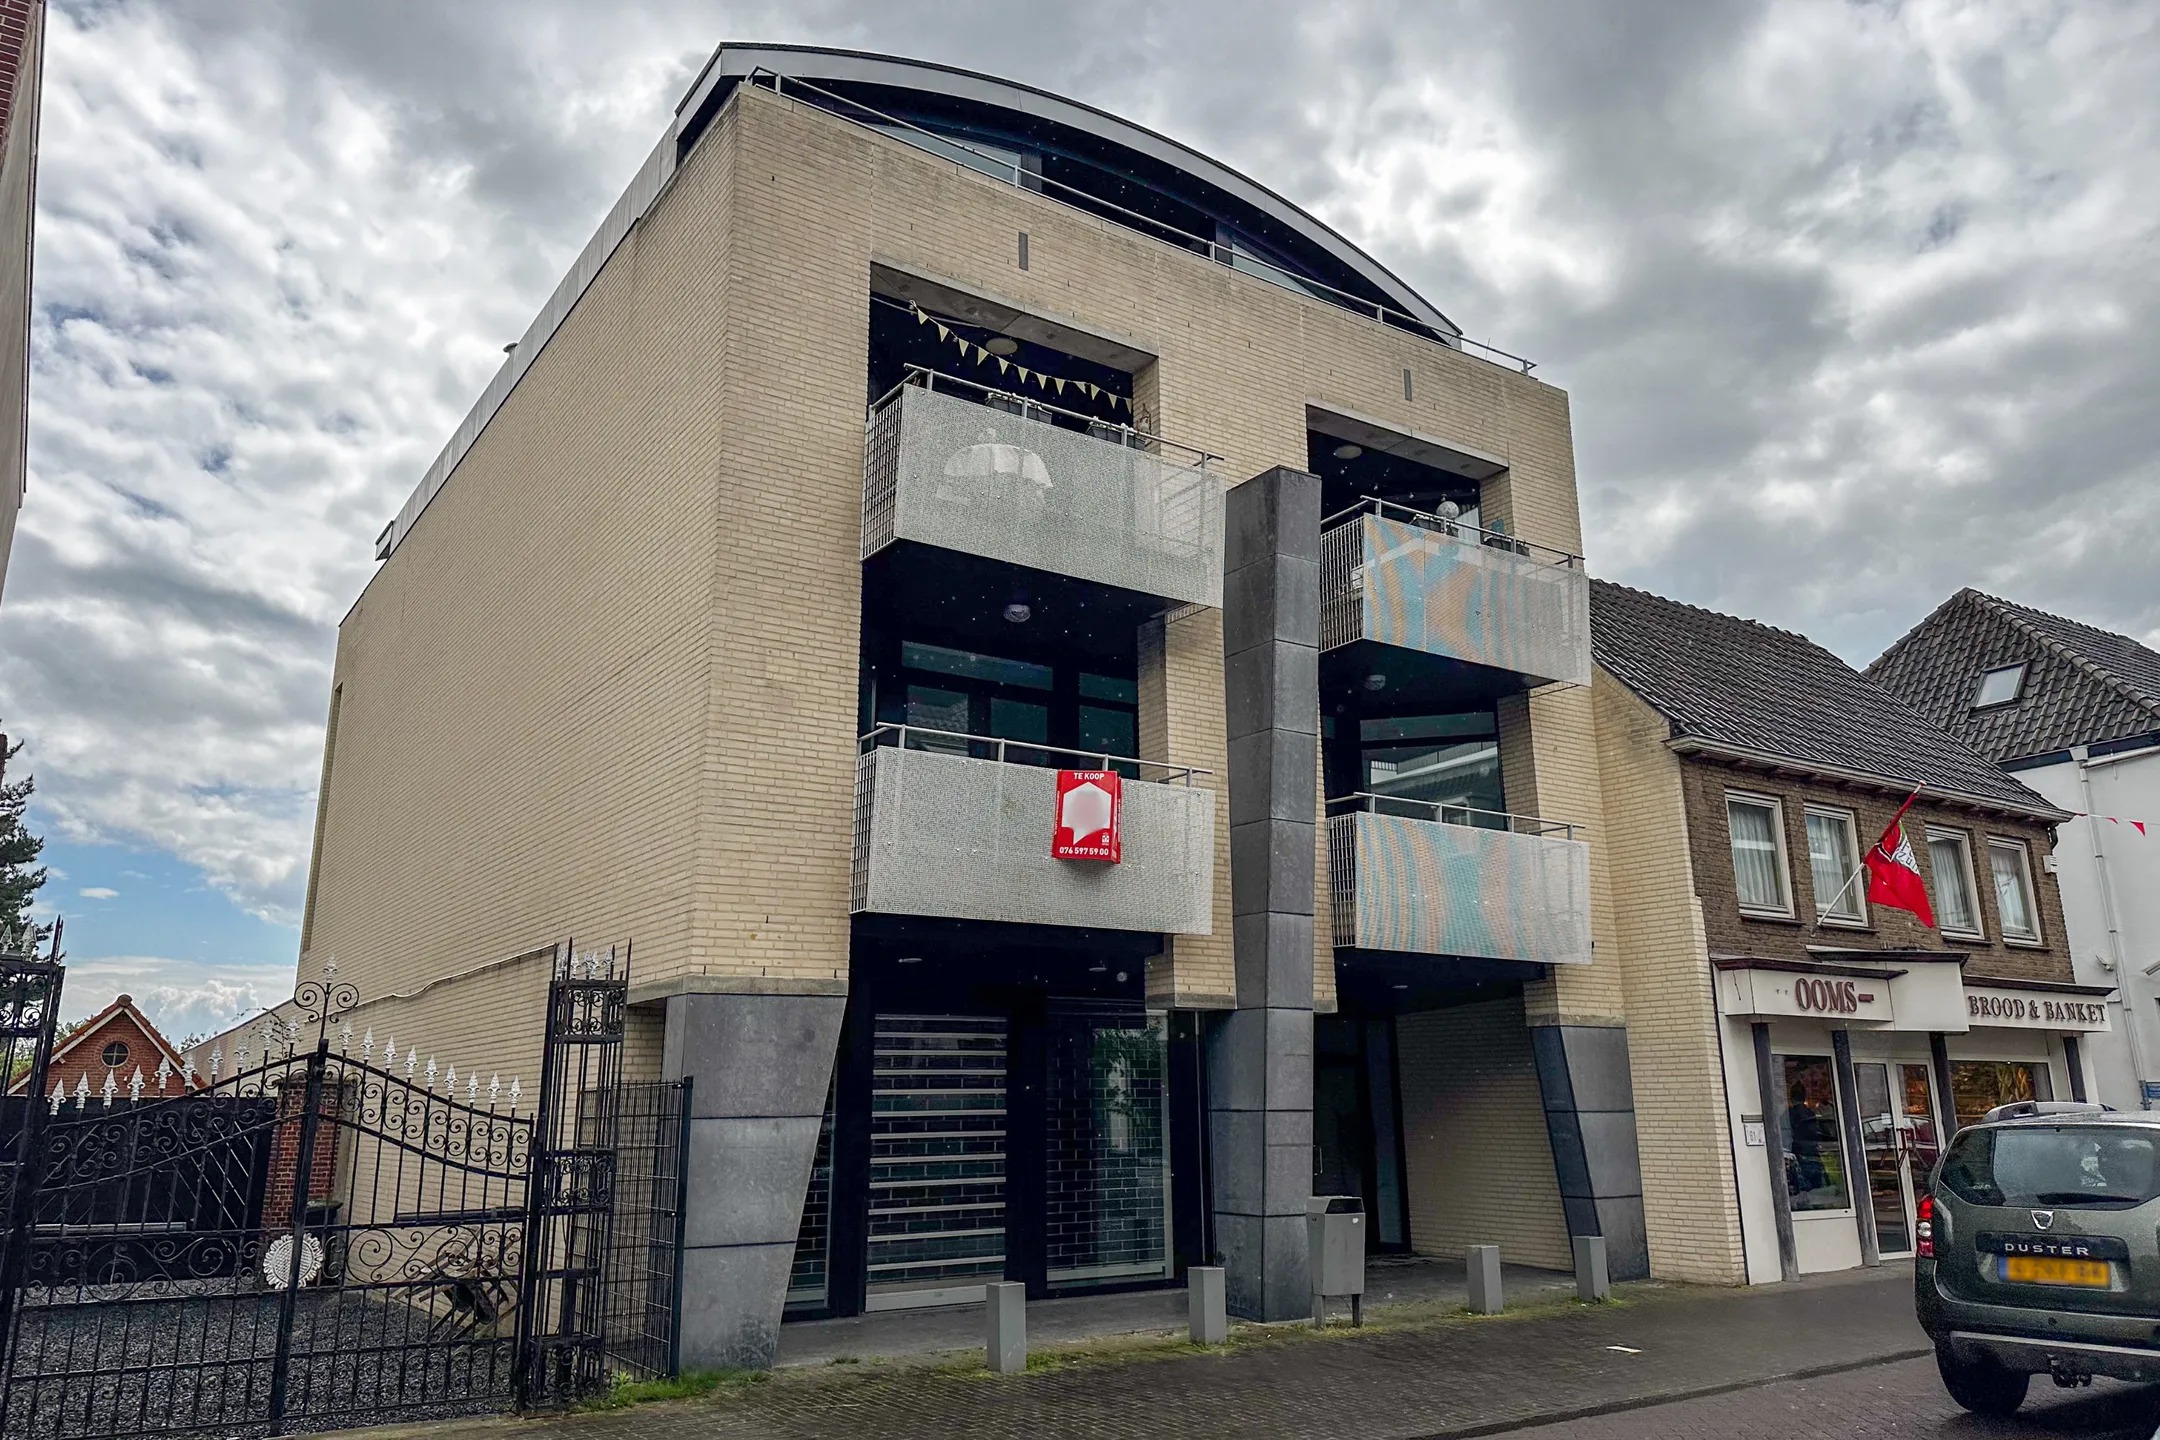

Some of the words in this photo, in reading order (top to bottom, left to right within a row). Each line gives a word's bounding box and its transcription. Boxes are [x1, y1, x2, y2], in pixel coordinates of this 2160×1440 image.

[1073, 772, 1084, 780] TE
[1059, 846, 1074, 855] 076
[1074, 847, 1088, 855] 597
[1089, 847, 1099, 855] 59
[1099, 848, 1109, 856] 00
[1968, 995, 2026, 1019] BROOD
[2028, 999, 2041, 1019] &
[2043, 1001, 2106, 1023] BANKET
[2004, 1242, 2089, 1256] DUSTER
